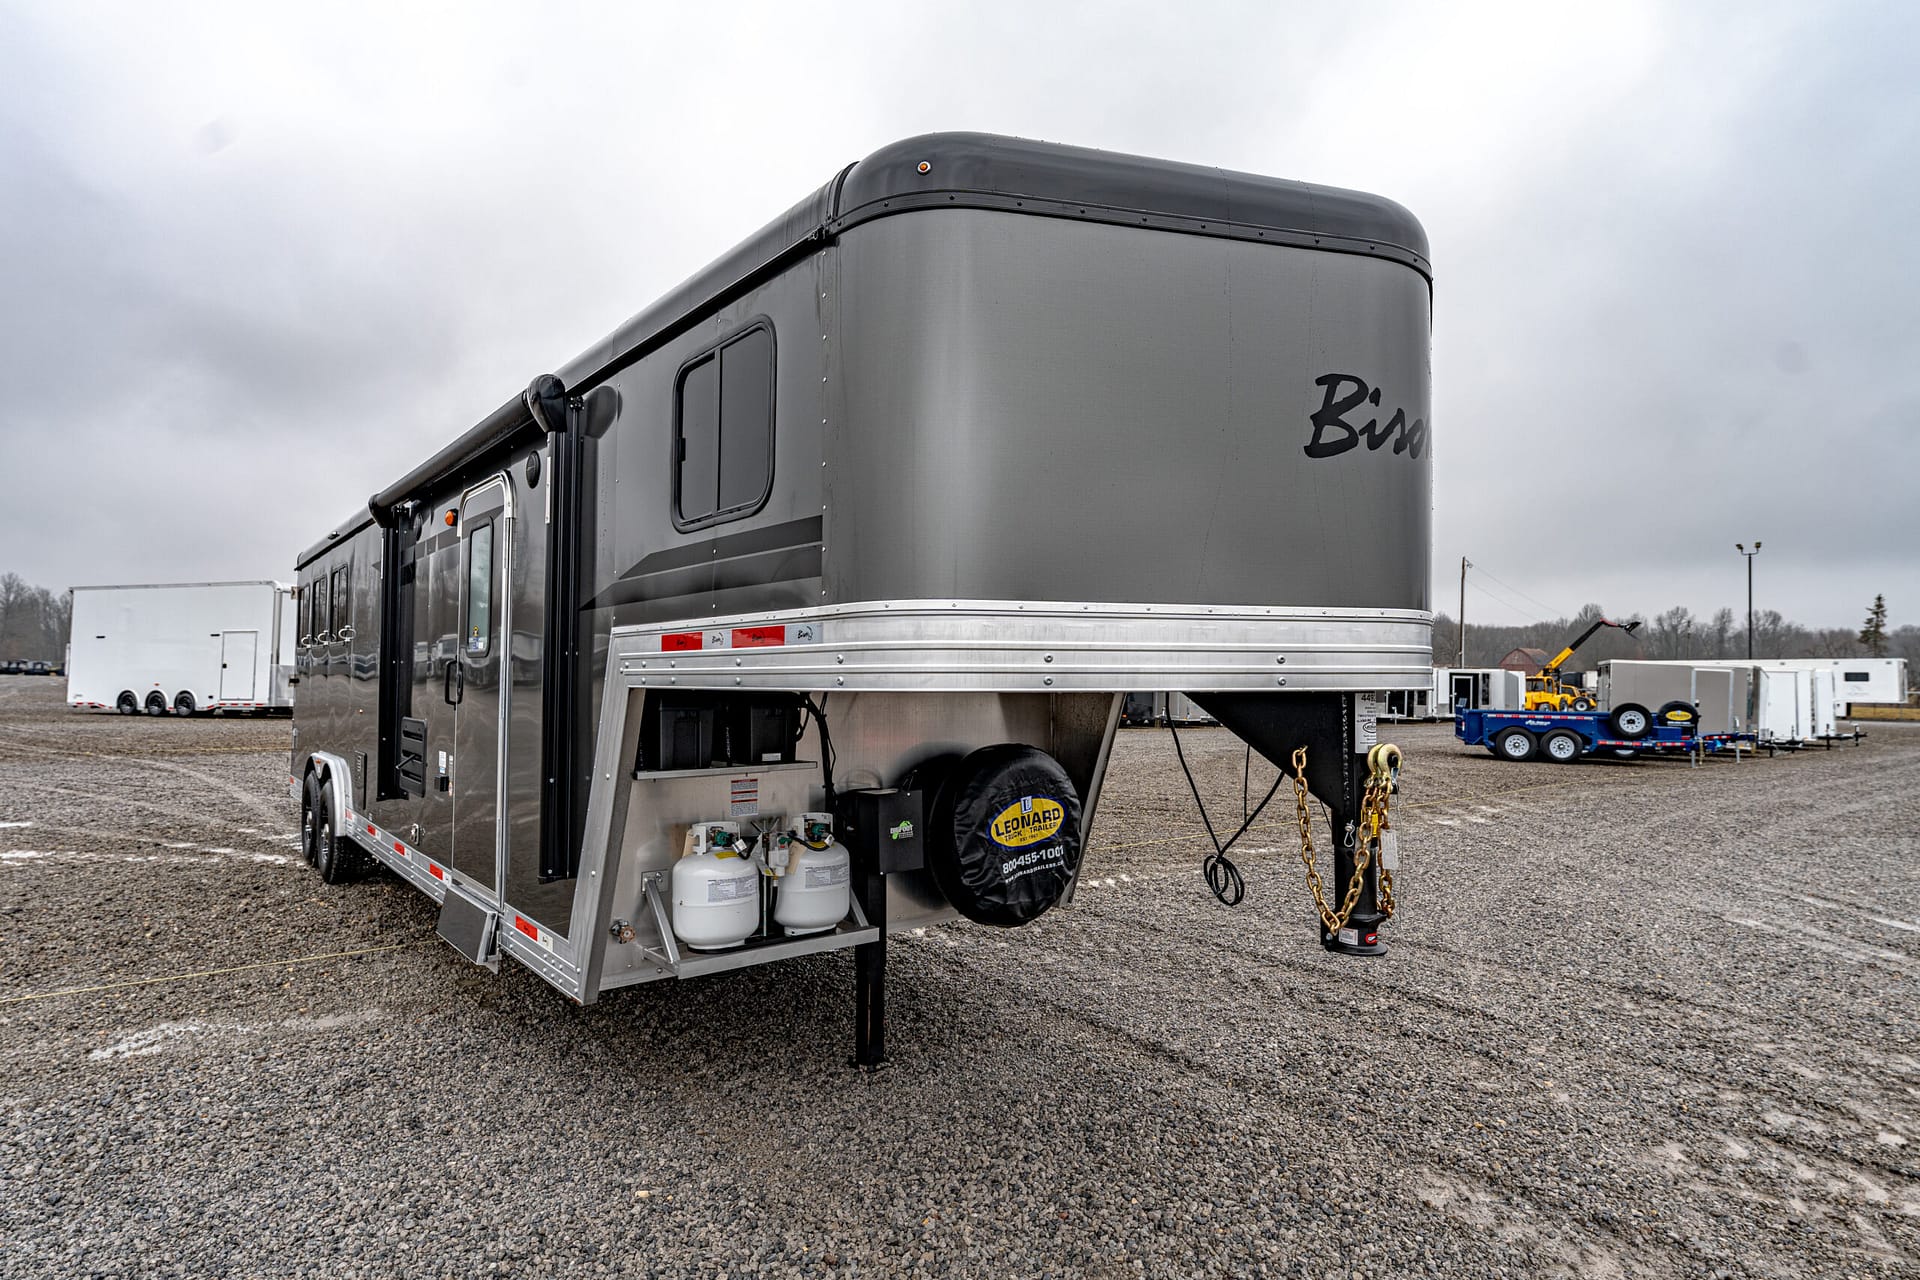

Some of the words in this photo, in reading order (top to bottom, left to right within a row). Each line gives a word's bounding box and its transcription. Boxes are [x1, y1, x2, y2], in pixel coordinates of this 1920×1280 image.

[1303, 373, 1432, 459] Biso
[994, 808, 1061, 837] LEONARD
[1029, 822, 1057, 834] TRAILER
